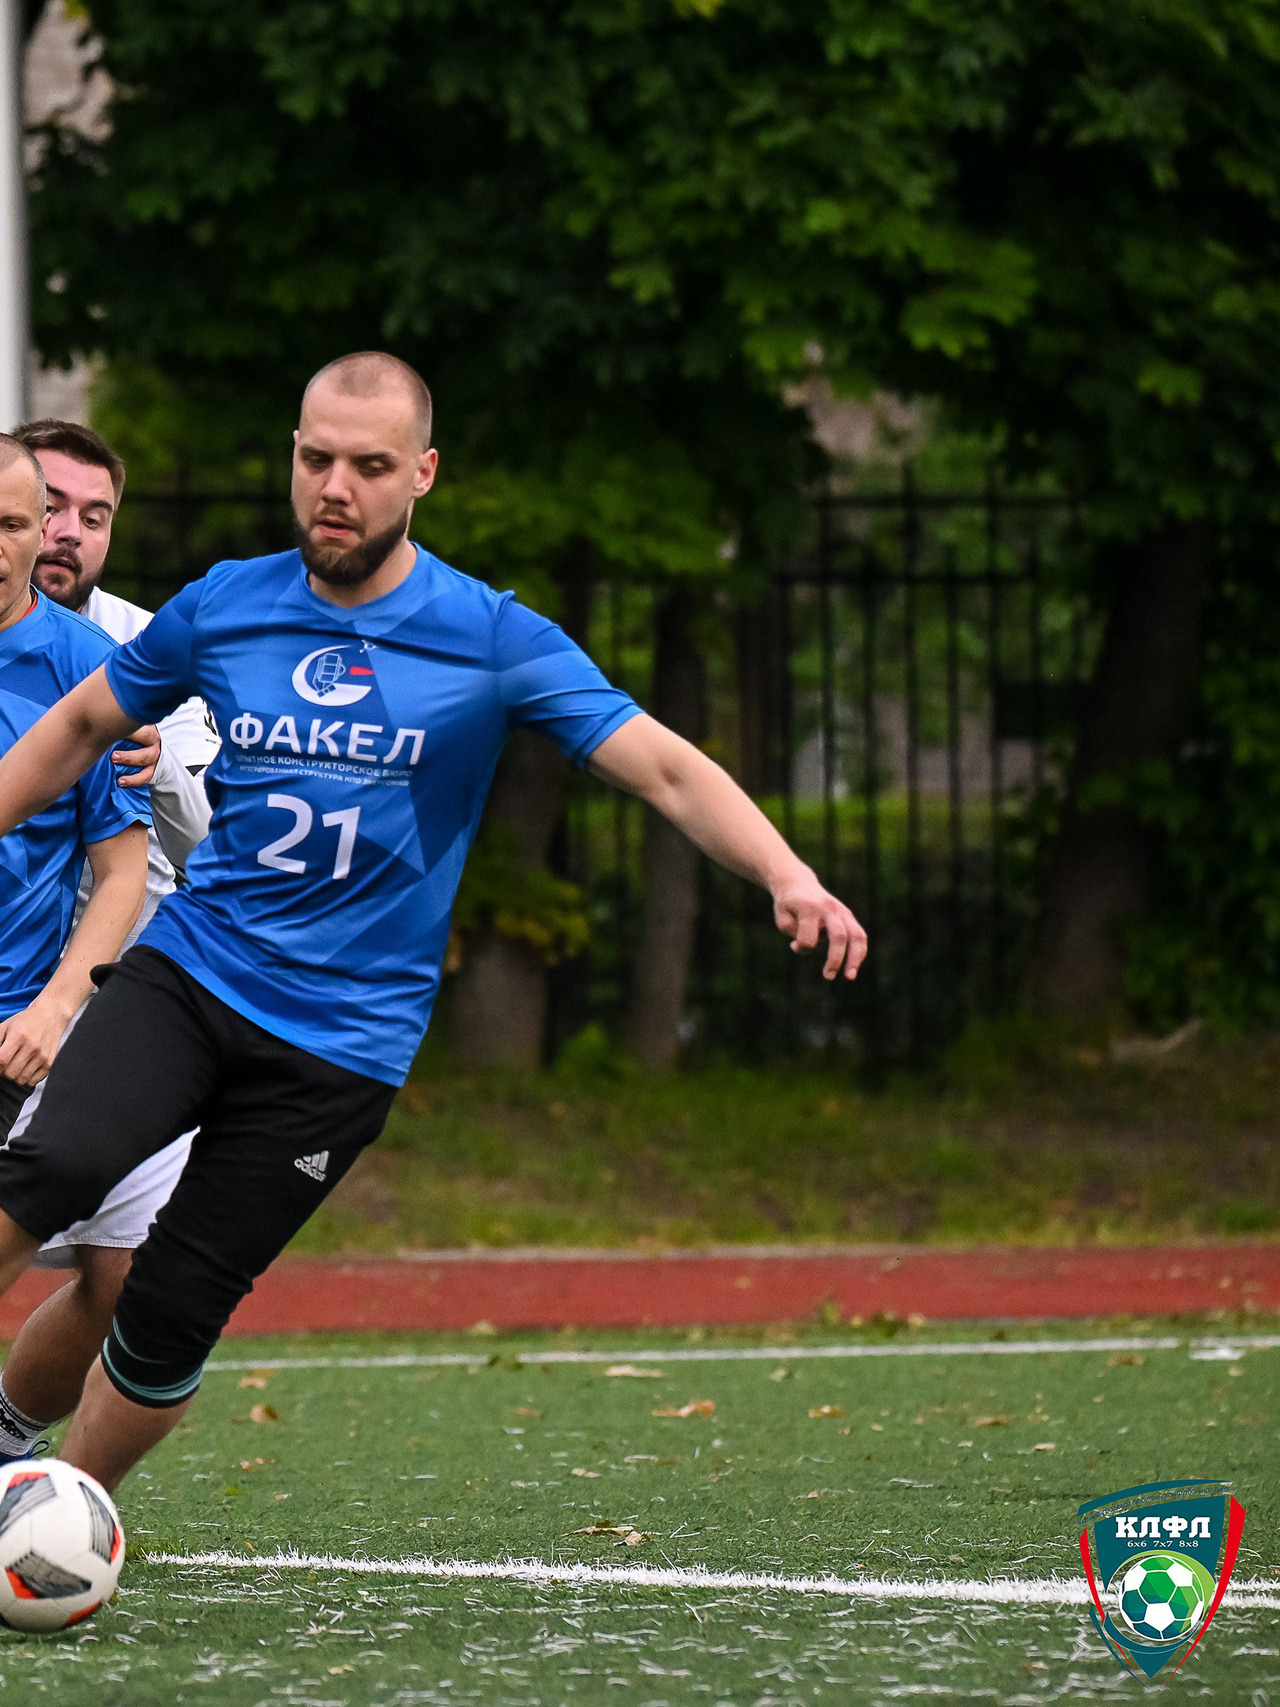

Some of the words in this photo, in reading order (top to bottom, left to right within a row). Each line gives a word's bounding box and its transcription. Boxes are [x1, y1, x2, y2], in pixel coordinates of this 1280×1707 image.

[229, 712, 426, 766] ФАКЕЛ
[277, 756, 380, 777] КОНСТРУКТОРСКОЕ
[257, 793, 361, 881] 21
